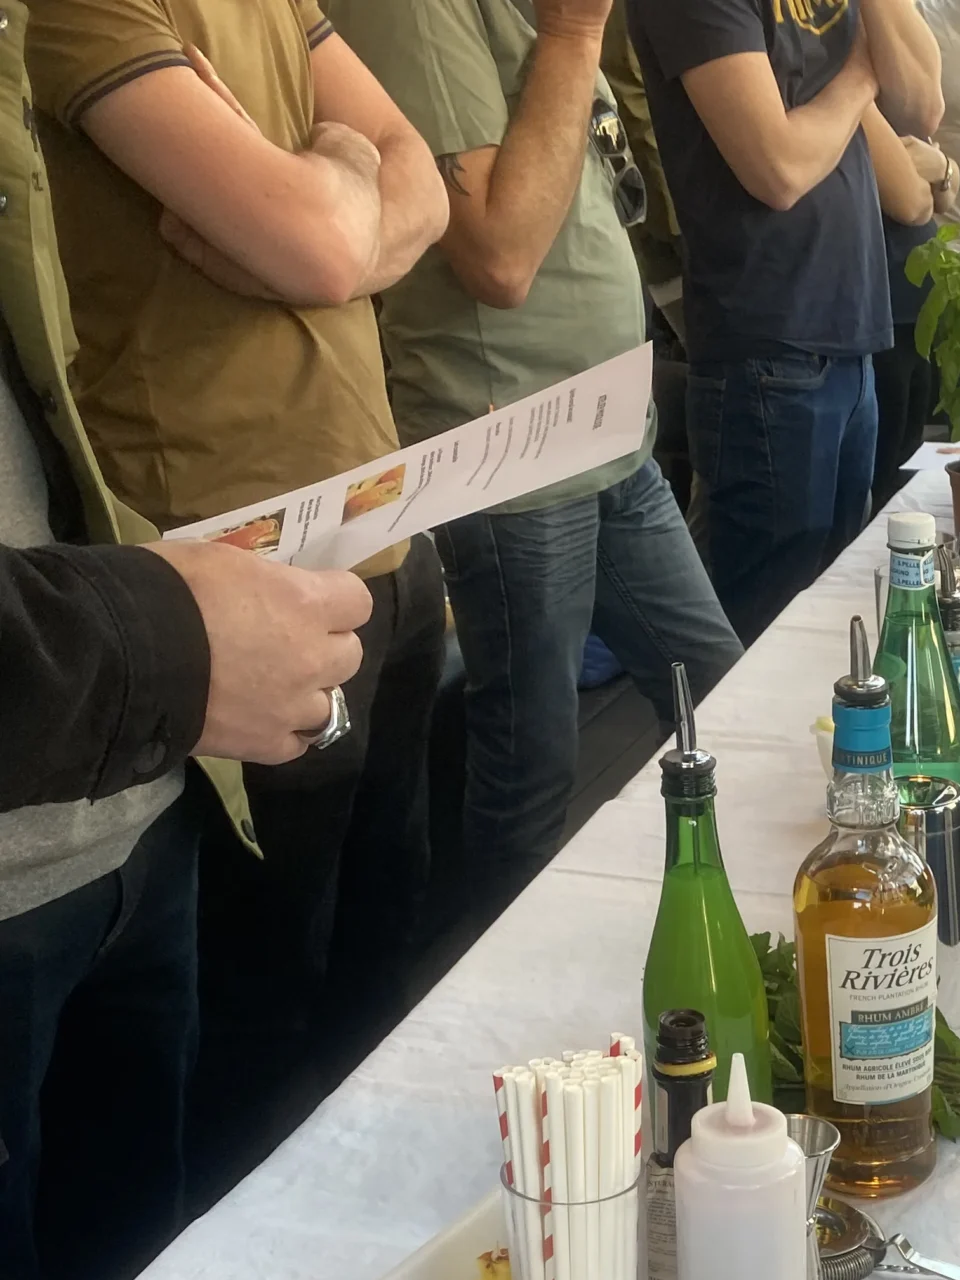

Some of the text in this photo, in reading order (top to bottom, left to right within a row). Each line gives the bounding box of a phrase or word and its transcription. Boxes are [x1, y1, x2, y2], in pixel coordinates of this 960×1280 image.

[861, 943, 922, 970] Trois
[839, 956, 934, 990] Rivières
[858, 1012, 892, 1023] RHUM
[842, 1063, 862, 1071] RHUM
[863, 1063, 893, 1072] AGRICOLE
